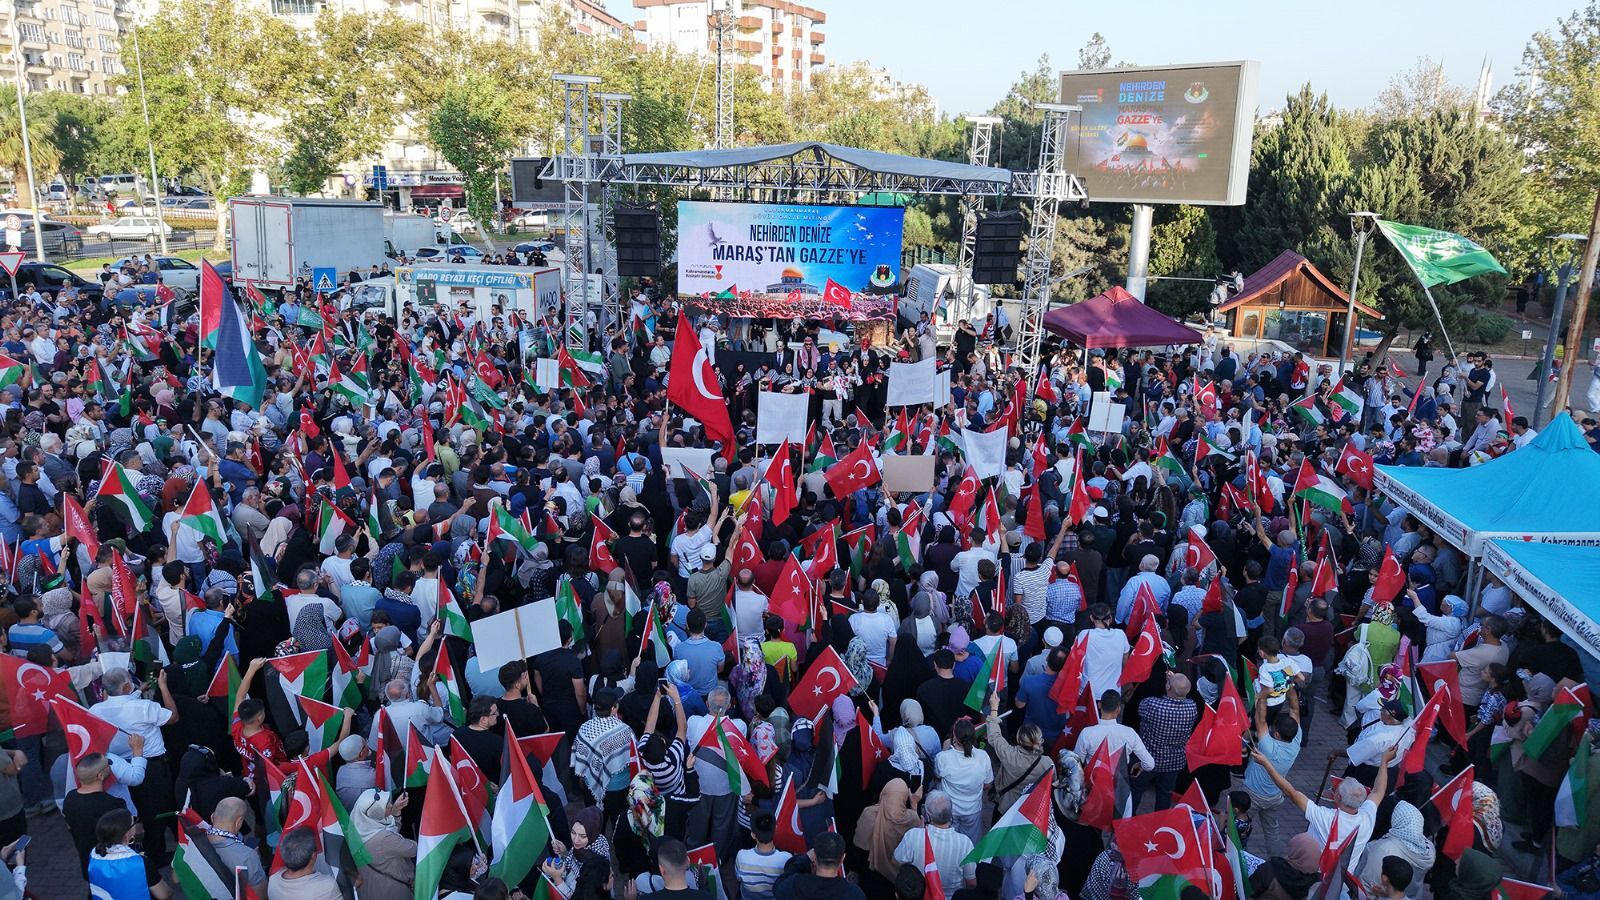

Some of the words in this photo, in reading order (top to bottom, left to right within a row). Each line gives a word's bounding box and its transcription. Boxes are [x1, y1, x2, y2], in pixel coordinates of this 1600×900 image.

[750, 223, 796, 243] NEHİRDEN
[800, 223, 832, 244] DENİZE
[713, 245, 796, 265] MARAŞ'TAN
[800, 247, 867, 265] GAZZE'YE
[416, 272, 439, 281] MADO
[440, 273, 465, 283] BEYAZI
[467, 273, 484, 285] KEÇİ
[485, 274, 516, 285] ÇİFTLİĞİ
[539, 290, 558, 308] MADO
